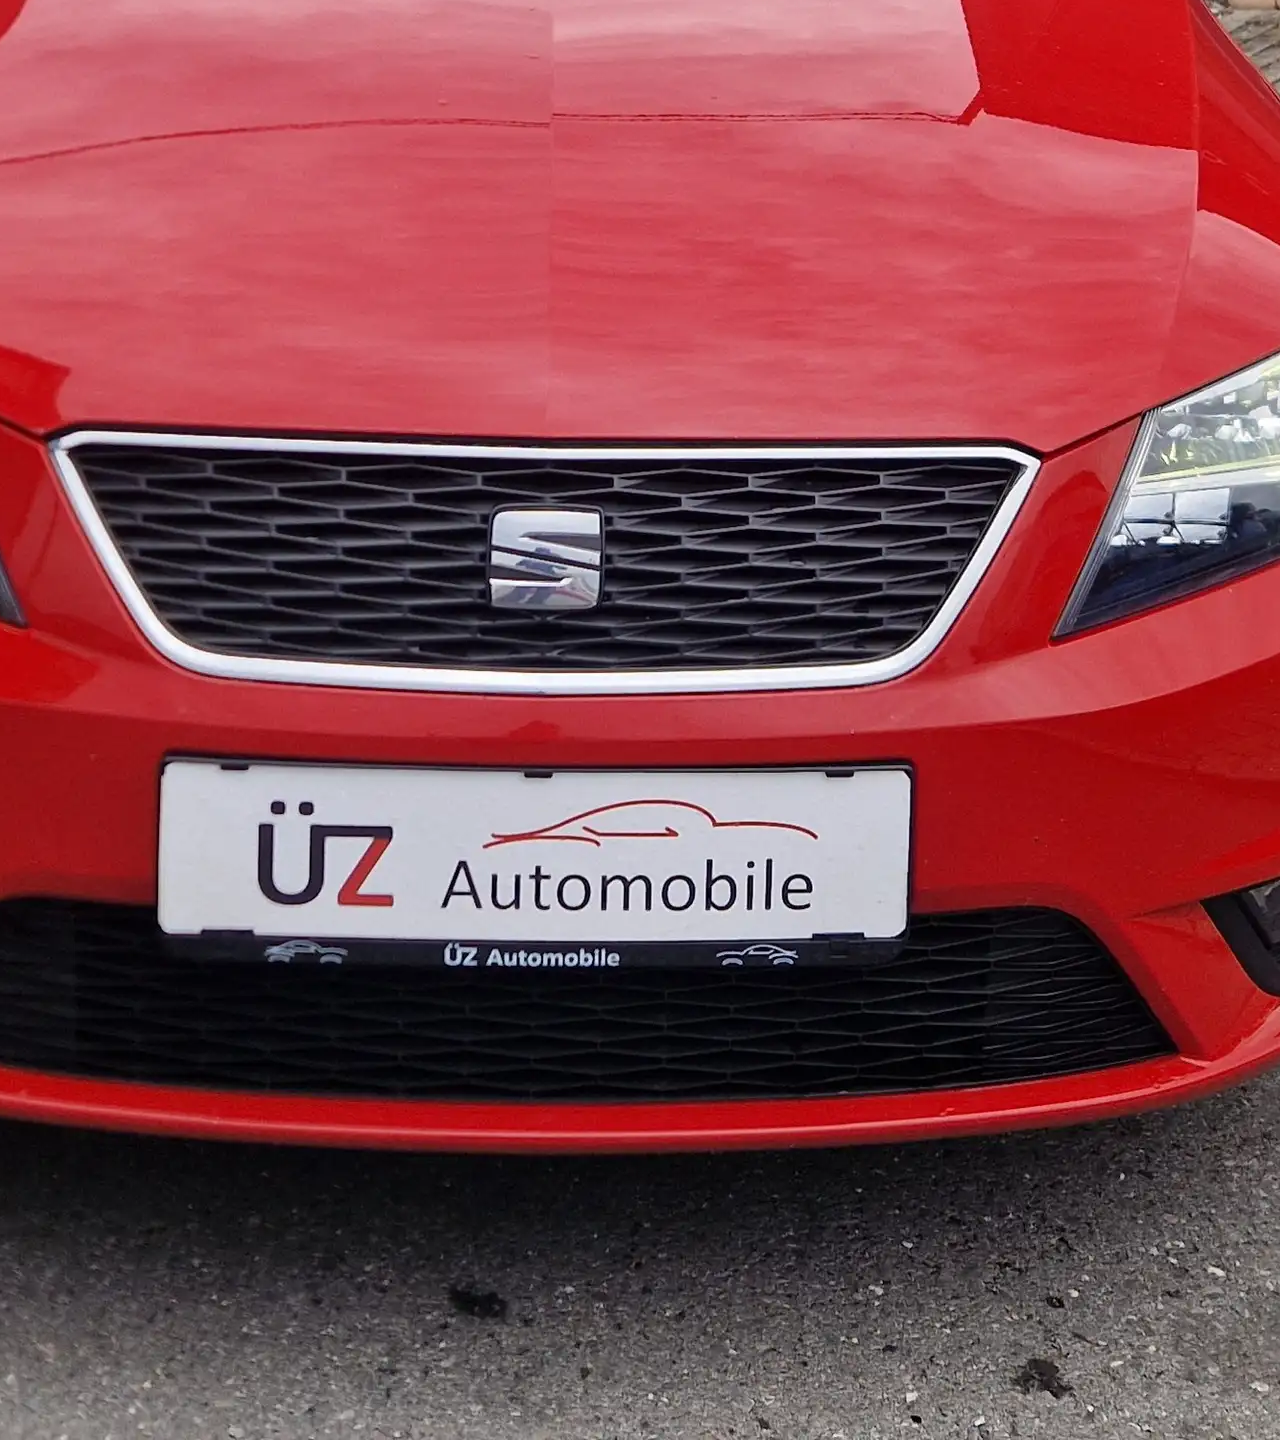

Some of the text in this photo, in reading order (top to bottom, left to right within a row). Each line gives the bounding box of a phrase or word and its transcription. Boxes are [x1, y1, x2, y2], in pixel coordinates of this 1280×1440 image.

[257, 800, 394, 907] ÜZ
[441, 858, 816, 914] Automobile
[443, 942, 621, 968] ÜZ Automobile
